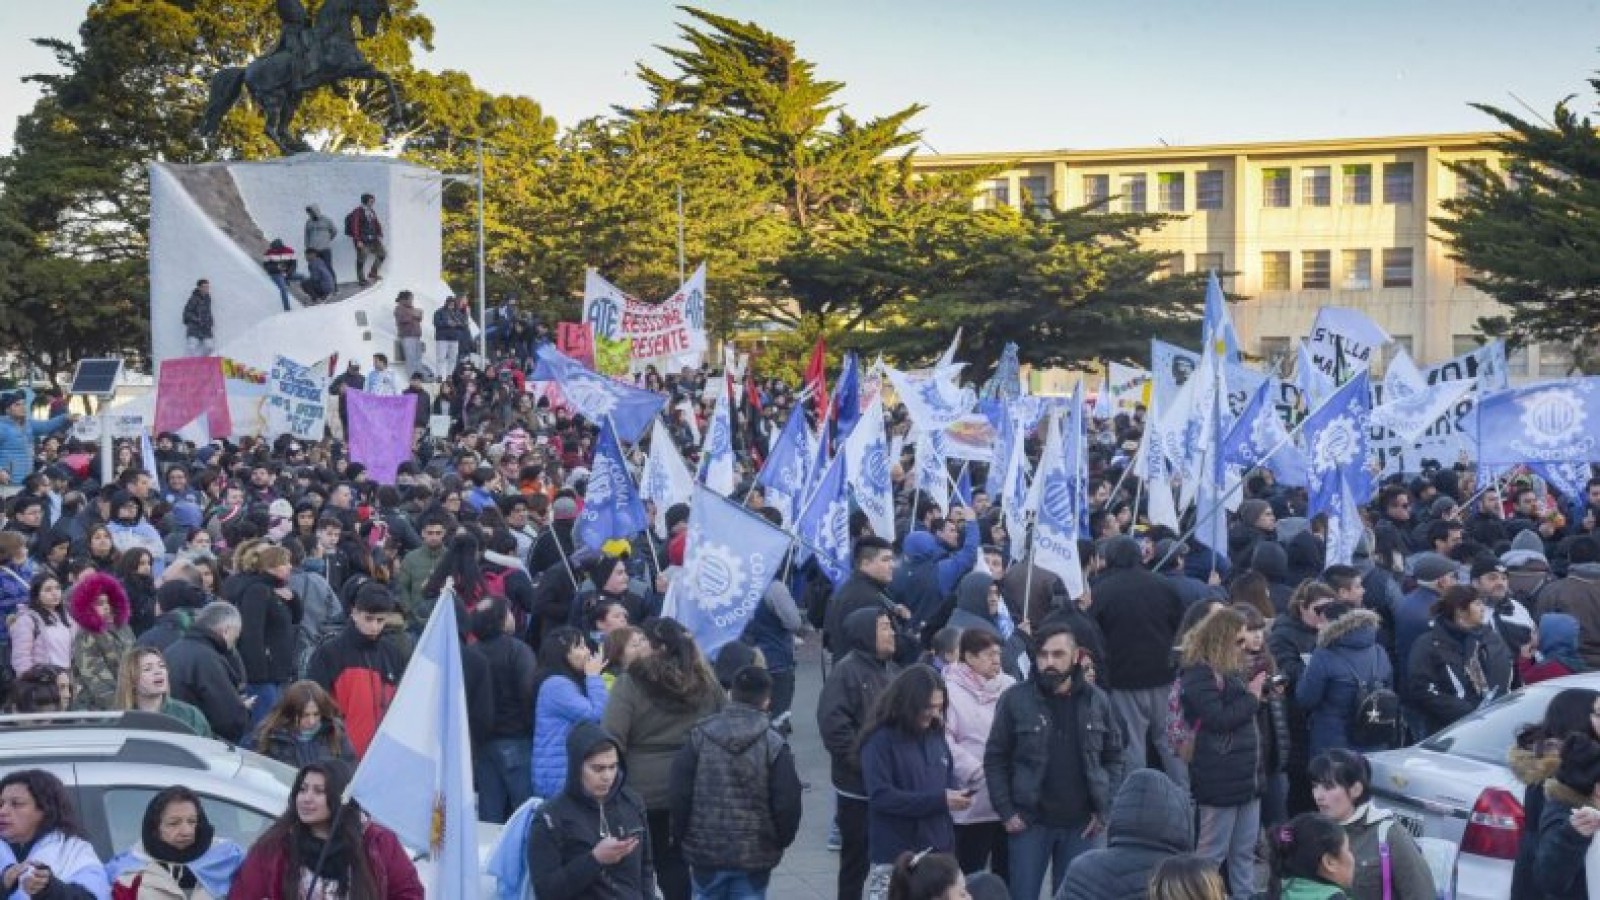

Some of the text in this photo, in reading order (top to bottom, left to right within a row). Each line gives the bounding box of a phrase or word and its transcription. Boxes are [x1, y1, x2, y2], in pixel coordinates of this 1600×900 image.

[588, 298, 619, 342] ATE
[620, 327, 689, 359] RESENTE
[1313, 328, 1371, 361] STLLA
